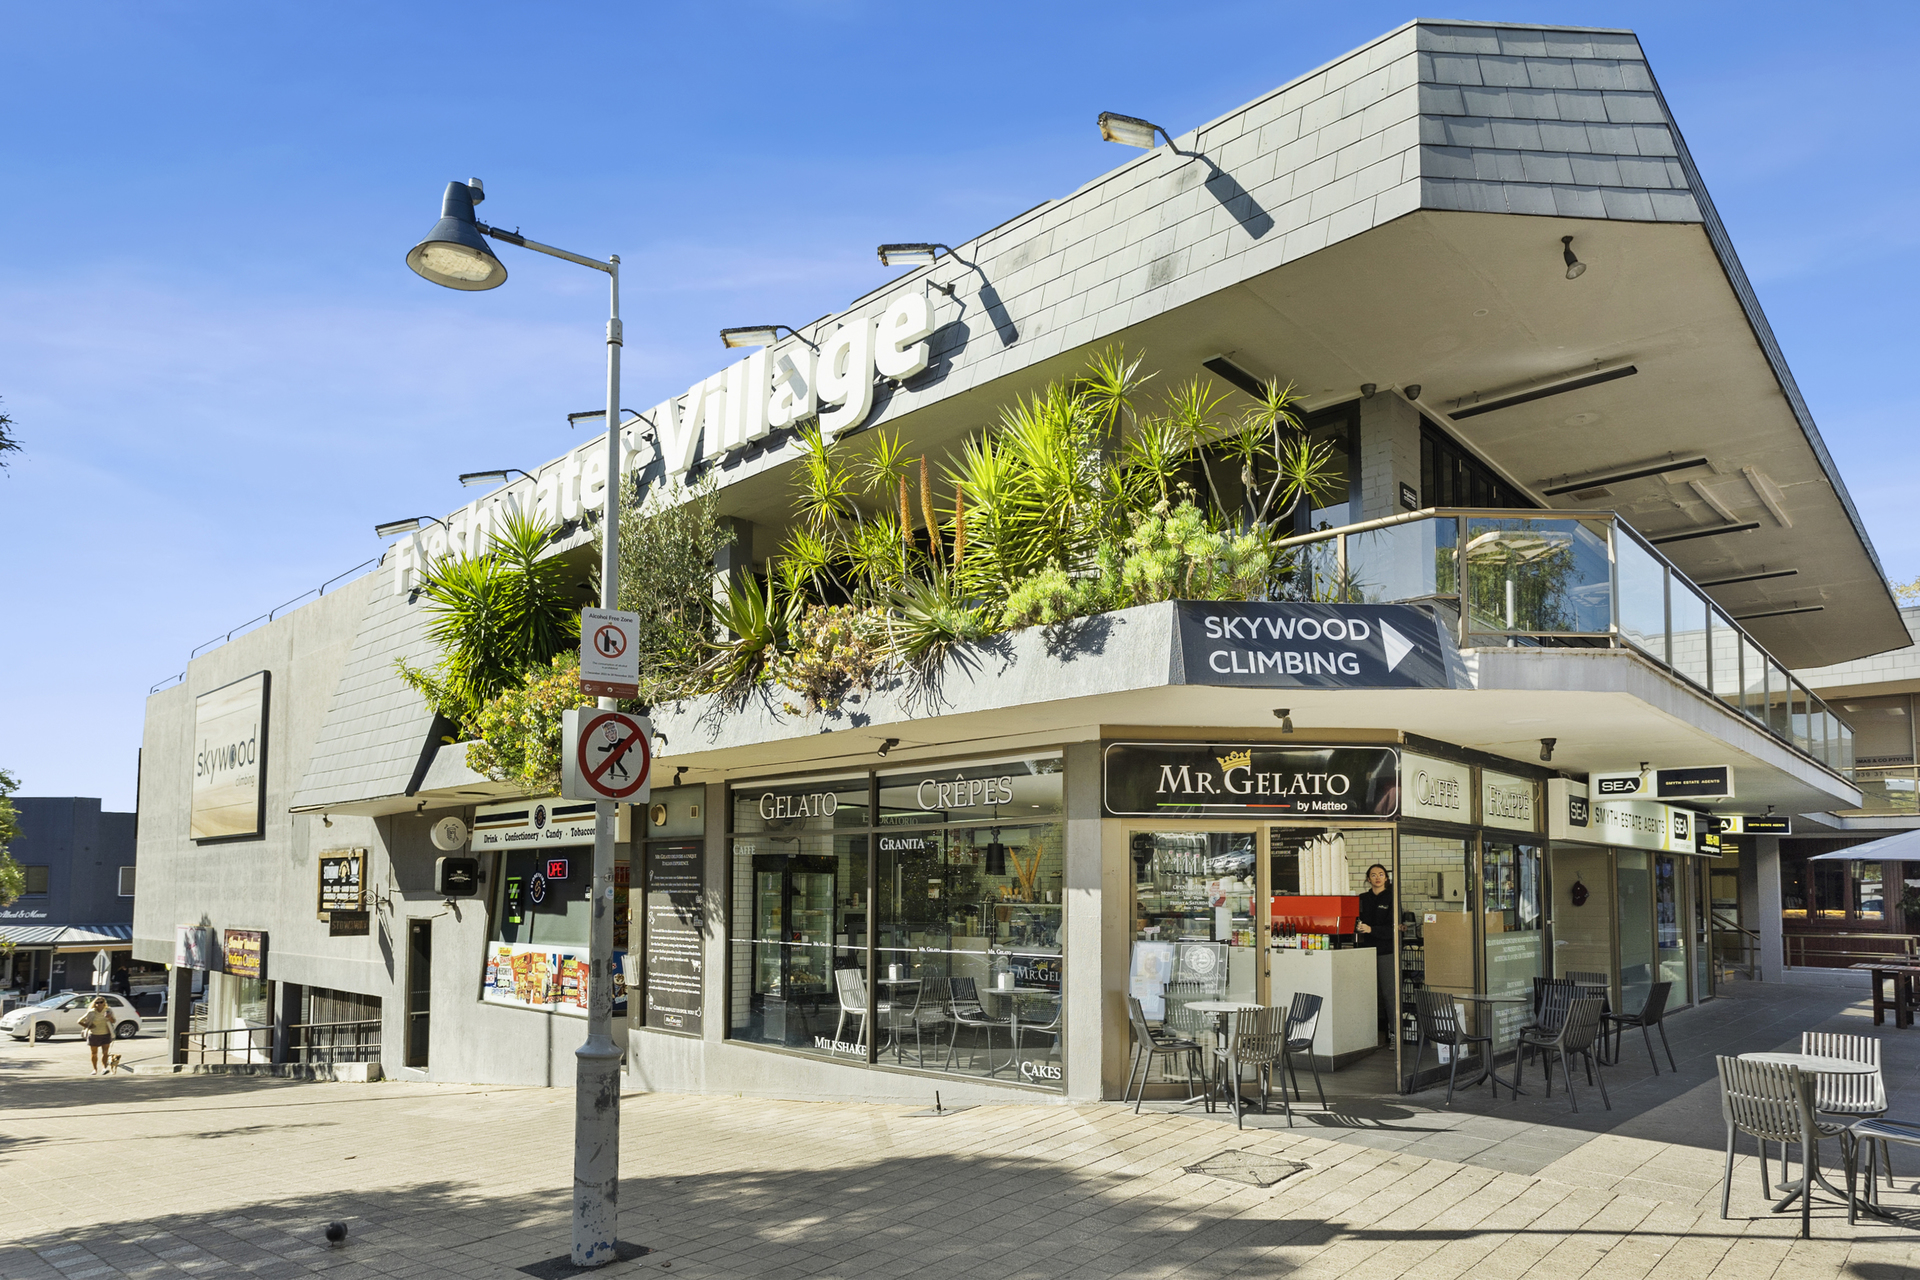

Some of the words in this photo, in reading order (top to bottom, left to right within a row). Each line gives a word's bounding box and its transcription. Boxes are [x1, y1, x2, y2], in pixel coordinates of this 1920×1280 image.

[656, 292, 934, 475] Village
[1204, 615, 1370, 641] SKYWOOD
[1208, 650, 1360, 675] CLIMBING
[197, 723, 257, 785] skywood
[1156, 763, 1221, 795] MR.
[1223, 764, 1350, 797] GELATO
[1601, 780, 1637, 792] SEA
[917, 773, 1013, 811] CRÊPES
[759, 792, 838, 820] GELATO
[1297, 801, 1310, 812] by
[1312, 800, 1348, 811] Matteo
[1570, 801, 1588, 821] SEA
[1595, 807, 1619, 827] SMYTH
[1621, 812, 1642, 831] ESTATE
[1644, 817, 1665, 834] AGENTS
[1674, 817, 1688, 835] SEA
[484, 834, 498, 844] Drink
[504, 831, 539, 843] Confectionery
[545, 828, 562, 840] Candy
[879, 837, 925, 851] GRANITA
[814, 1035, 867, 1056] MILKSHAKE
[1021, 1061, 1062, 1080] CAKES
